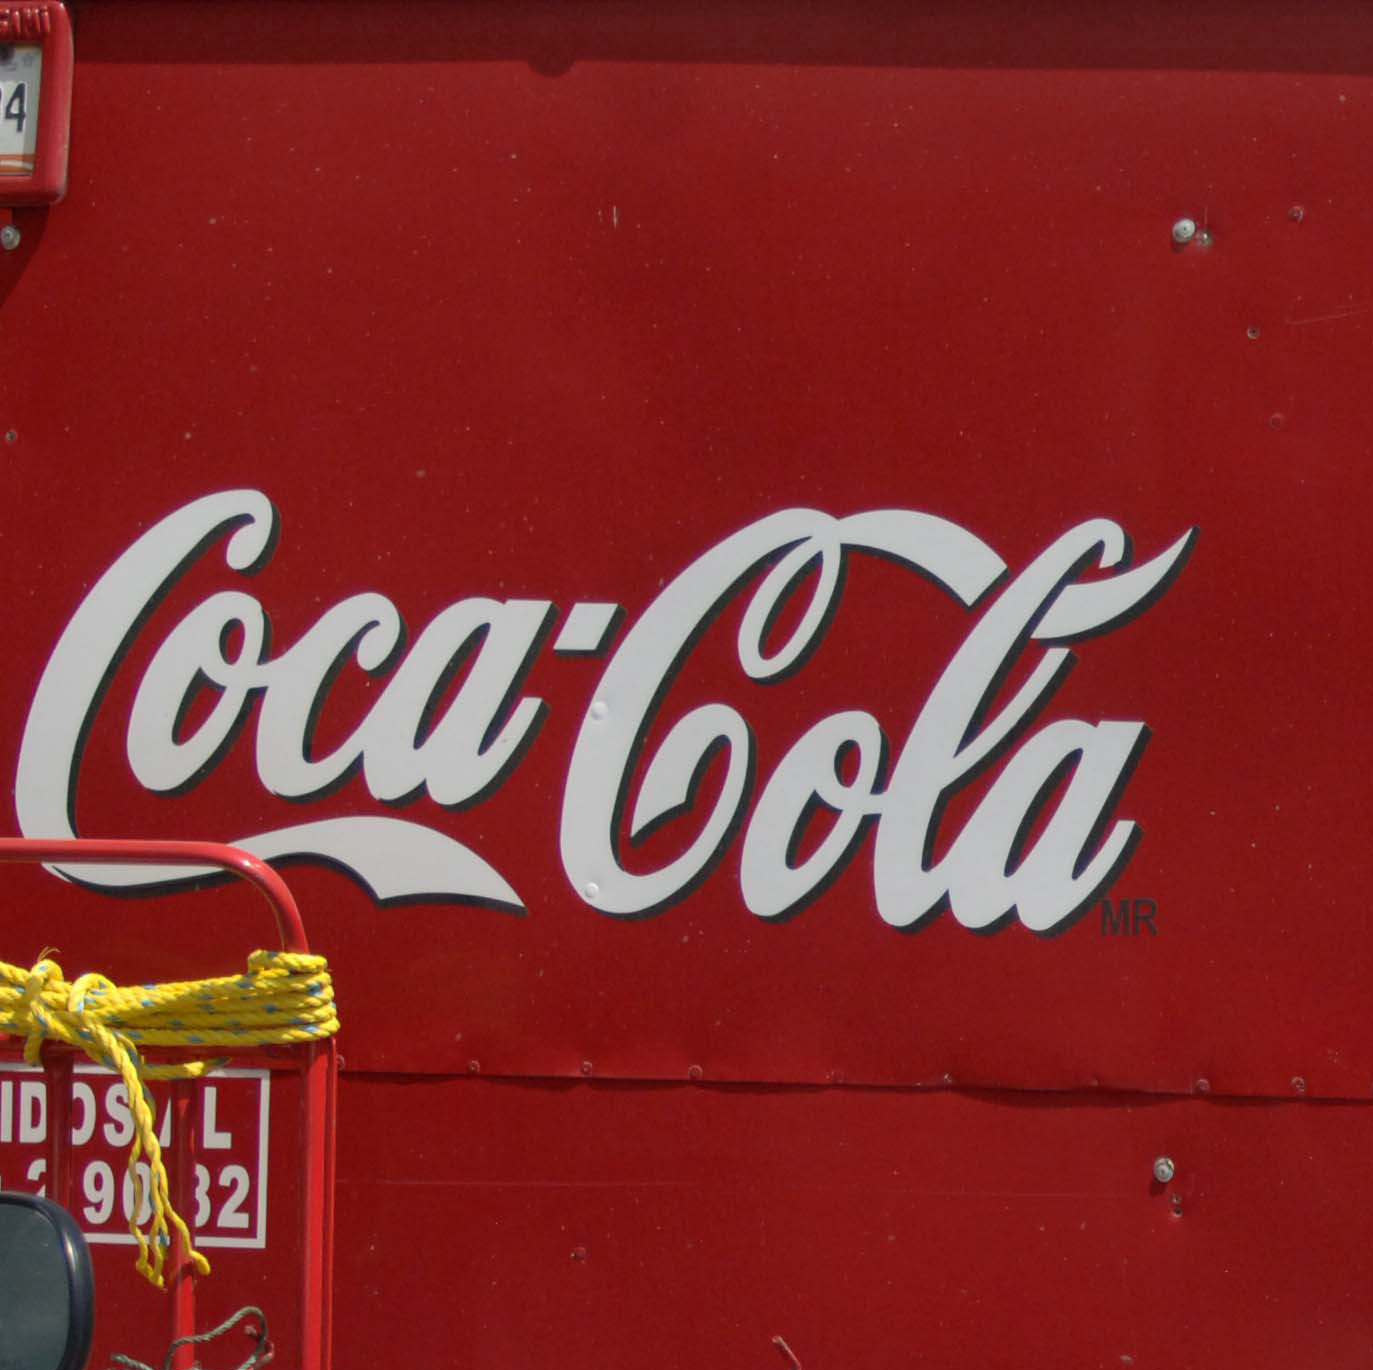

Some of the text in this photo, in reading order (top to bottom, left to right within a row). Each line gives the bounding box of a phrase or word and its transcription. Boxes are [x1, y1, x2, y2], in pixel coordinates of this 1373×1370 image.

[0, 82, 27, 133] 4
[15, 487, 1197, 938] Coca-Cola
[1102, 898, 1160, 938] MR
